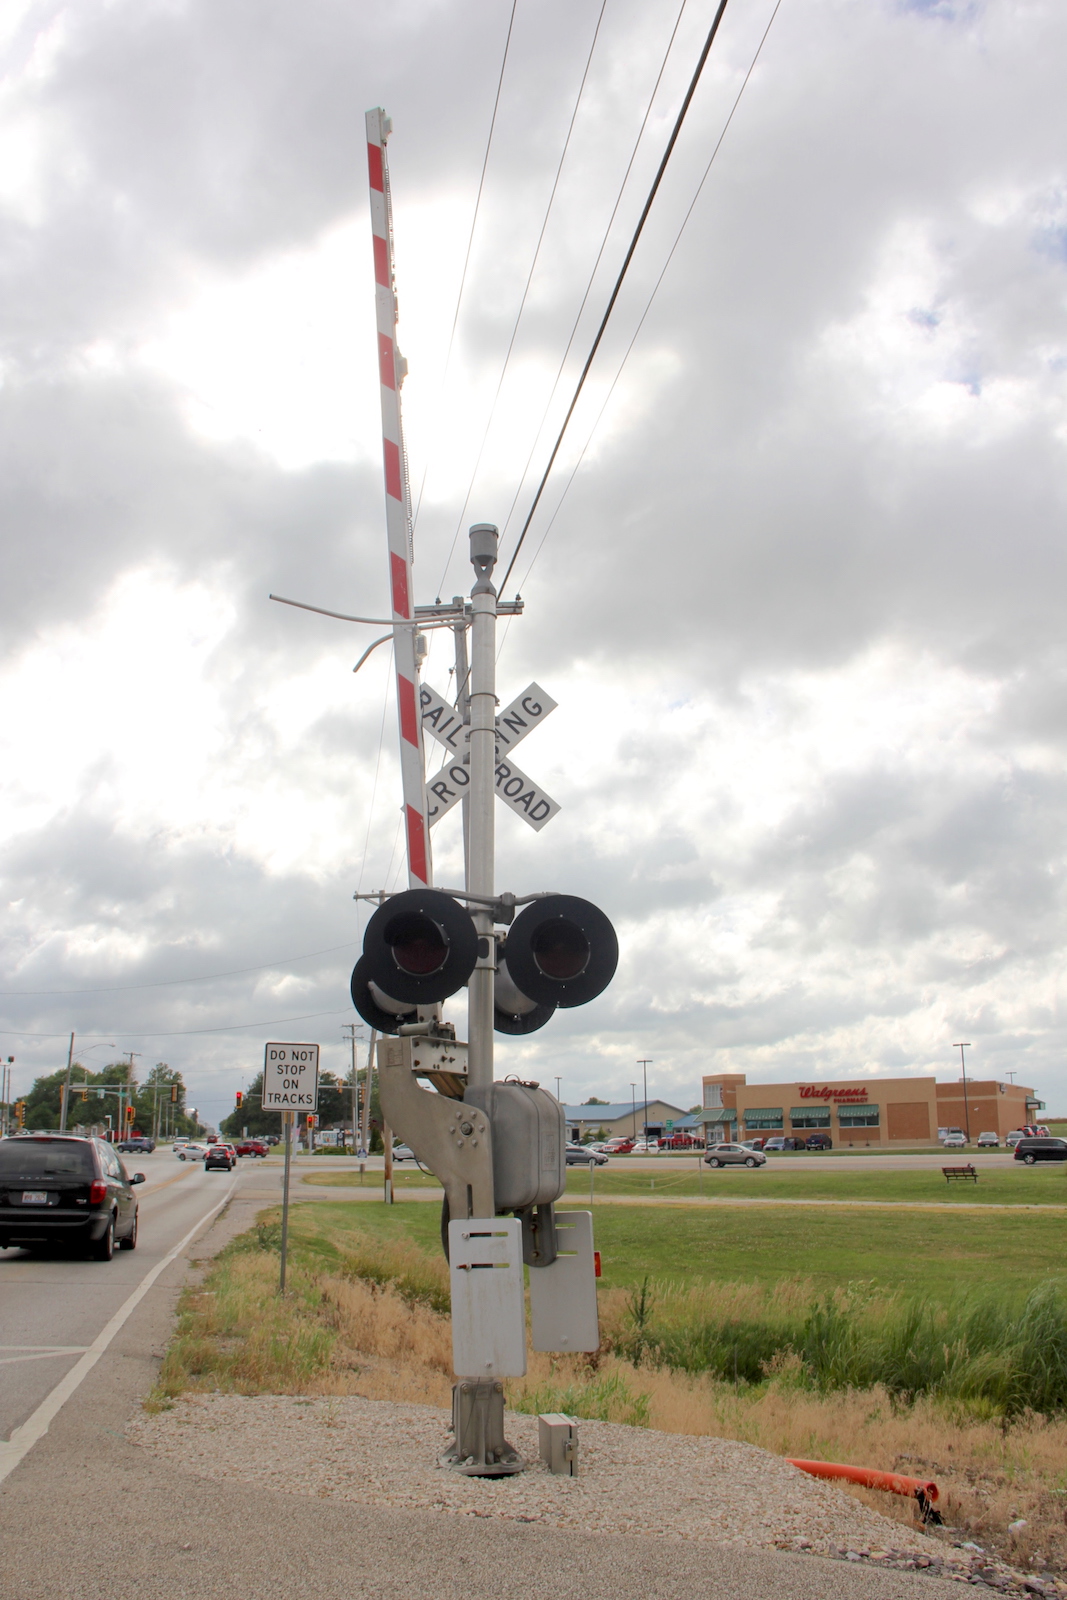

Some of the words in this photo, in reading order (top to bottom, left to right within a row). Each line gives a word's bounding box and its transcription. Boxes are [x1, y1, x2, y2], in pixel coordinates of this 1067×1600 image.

[270, 1050, 286, 1060] DO
[291, 1050, 314, 1061] NOT
[277, 1064, 306, 1075] STOP
[283, 1079, 298, 1089] ON
[268, 1093, 312, 1104] TRACKS
[798, 1085, 868, 1101] Walgreens
